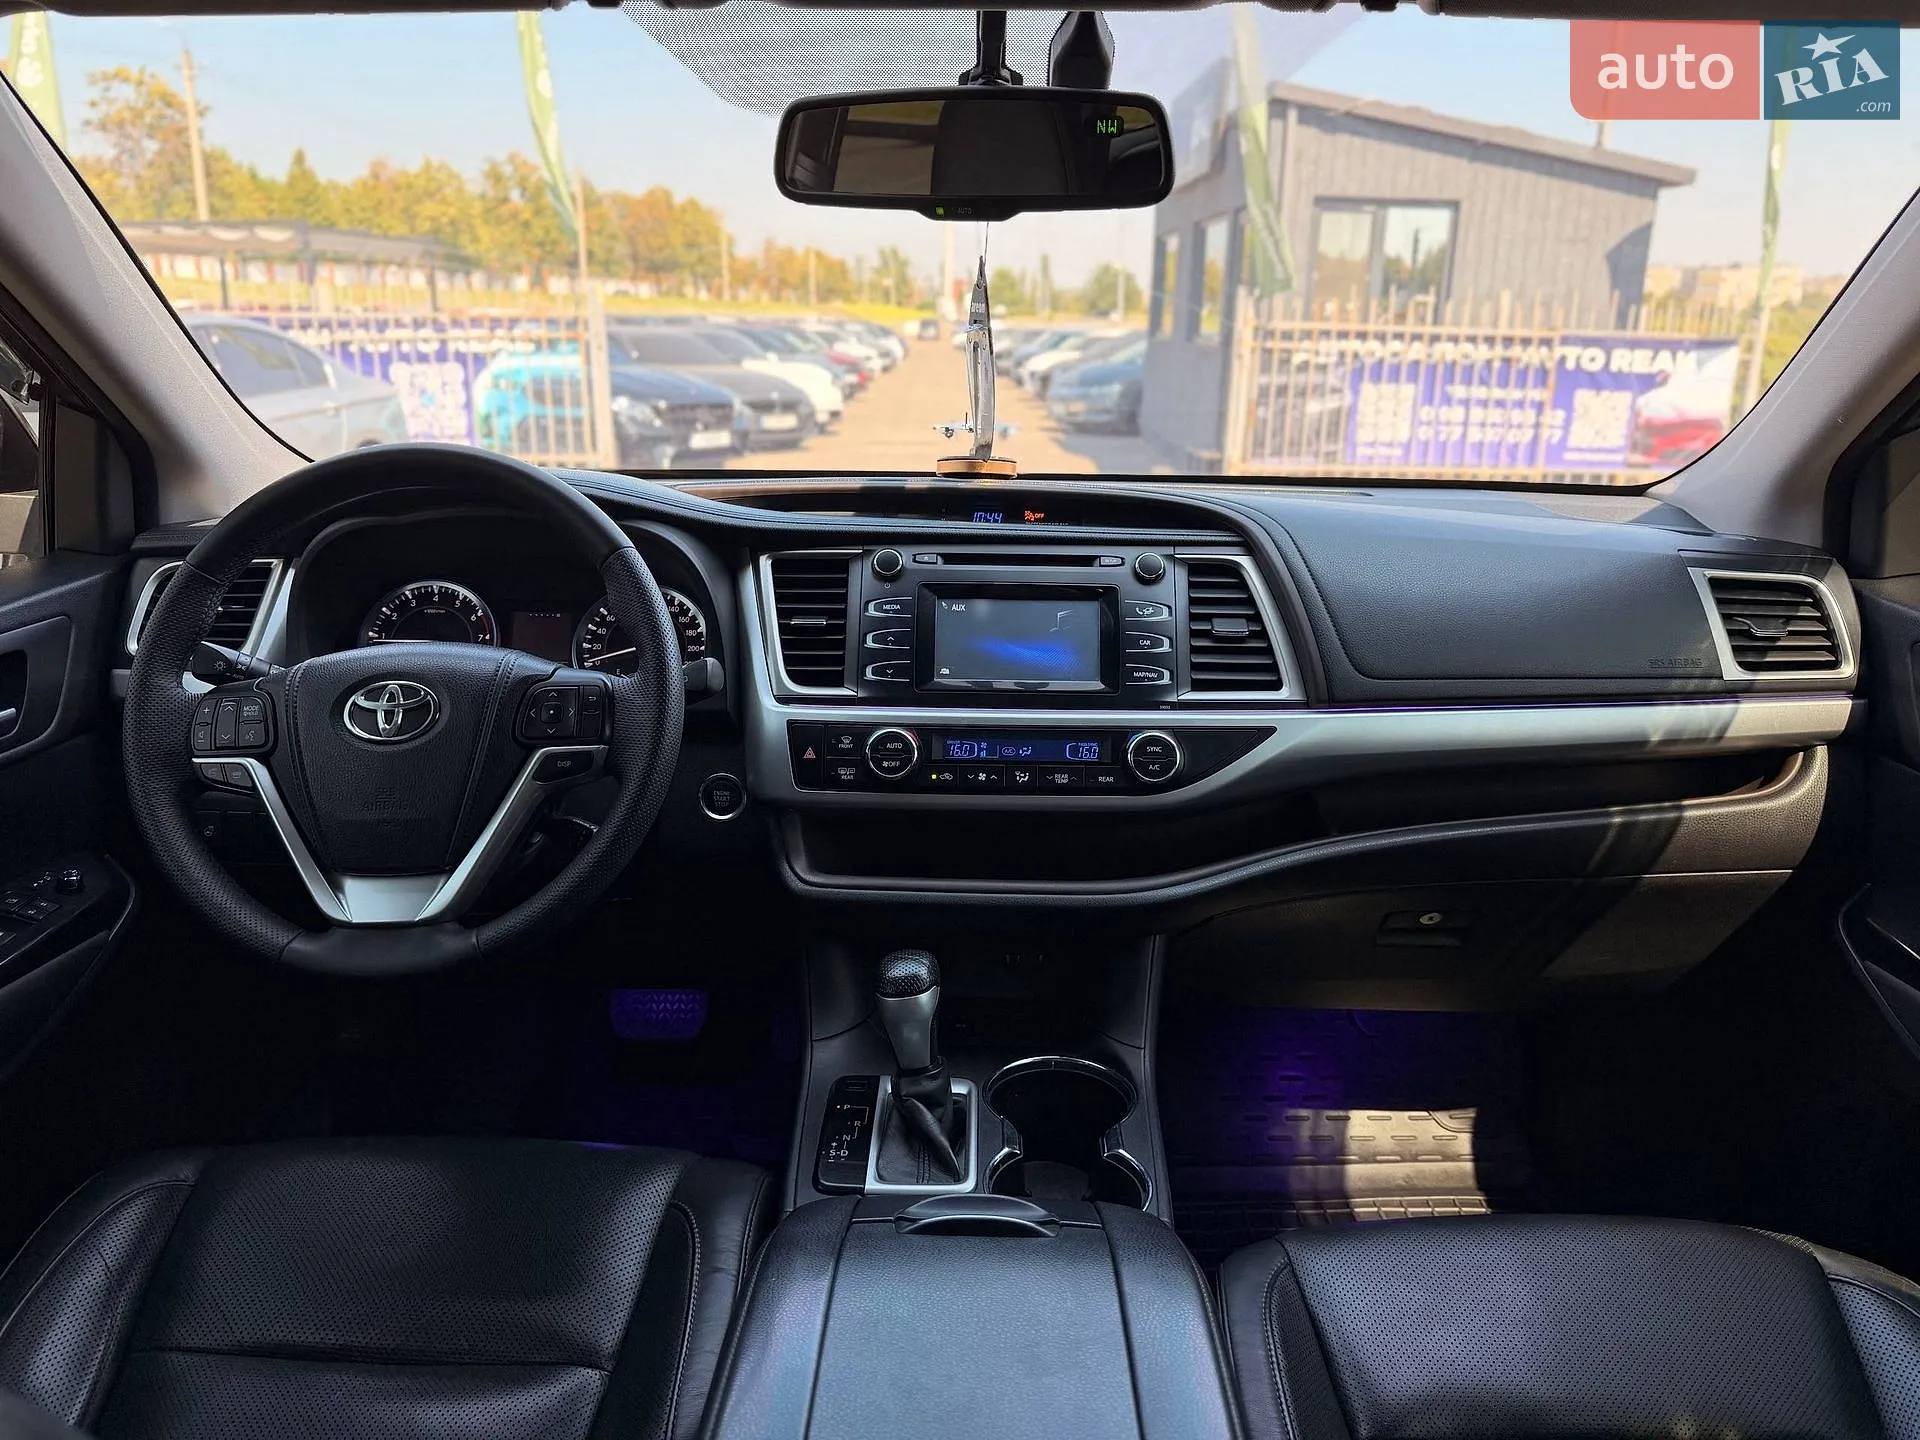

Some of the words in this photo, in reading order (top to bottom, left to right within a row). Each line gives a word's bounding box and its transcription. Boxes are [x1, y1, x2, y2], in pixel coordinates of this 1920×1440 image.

[1096, 119, 1118, 134] NW
[951, 603, 966, 612] AUX
[679, 616, 690, 624] 160
[685, 629, 697, 637] 180
[592, 643, 602, 651] 20
[687, 645, 700, 653] 200
[1133, 671, 1158, 679] MAP/NAV
[949, 744, 970, 757] 16.0
[1078, 746, 1099, 759] 16.0
[1146, 745, 1163, 753] SYNC
